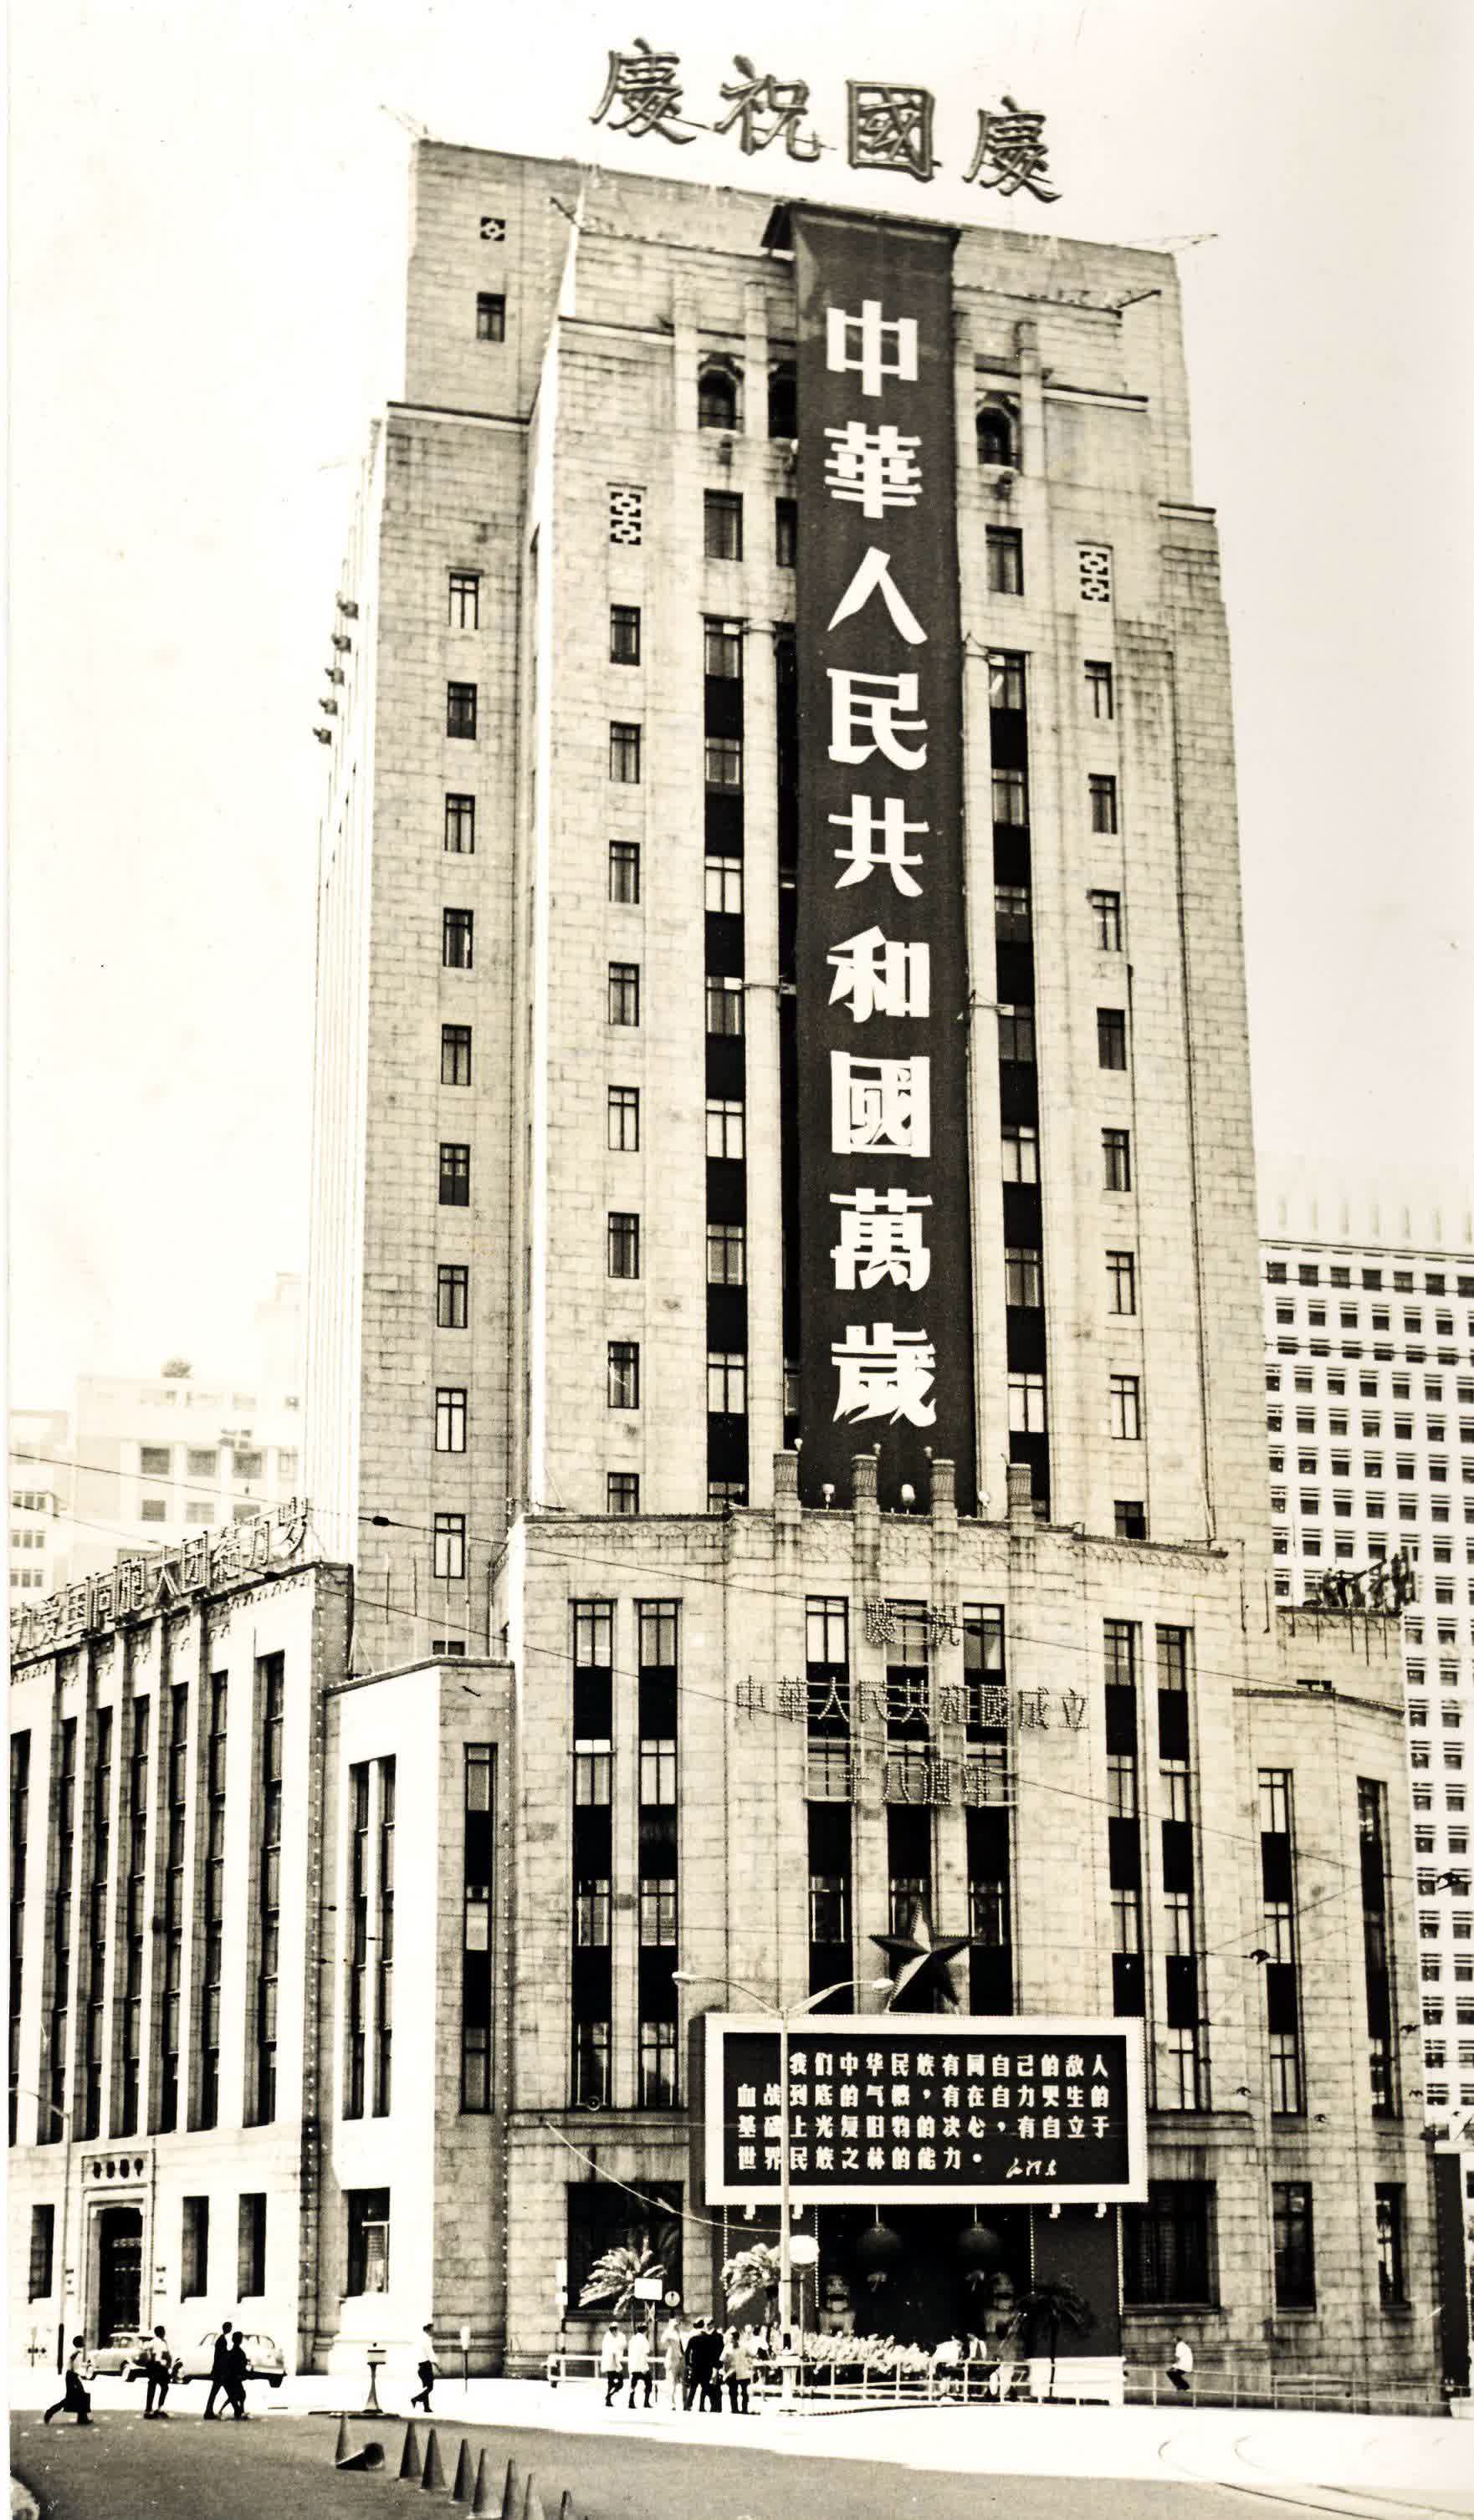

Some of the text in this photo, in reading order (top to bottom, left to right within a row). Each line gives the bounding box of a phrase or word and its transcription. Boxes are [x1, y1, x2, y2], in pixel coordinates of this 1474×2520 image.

[589, 38, 1063, 202] 慶祝國慶
[824, 299, 938, 1427] 中華人民共和國萬歲
[864, 1598, 961, 1647] 慶祝
[735, 1674, 1091, 1731] 中華人民共和國成立
[789, 2052, 1109, 2079] 我们中华民族有同自己的敌人
